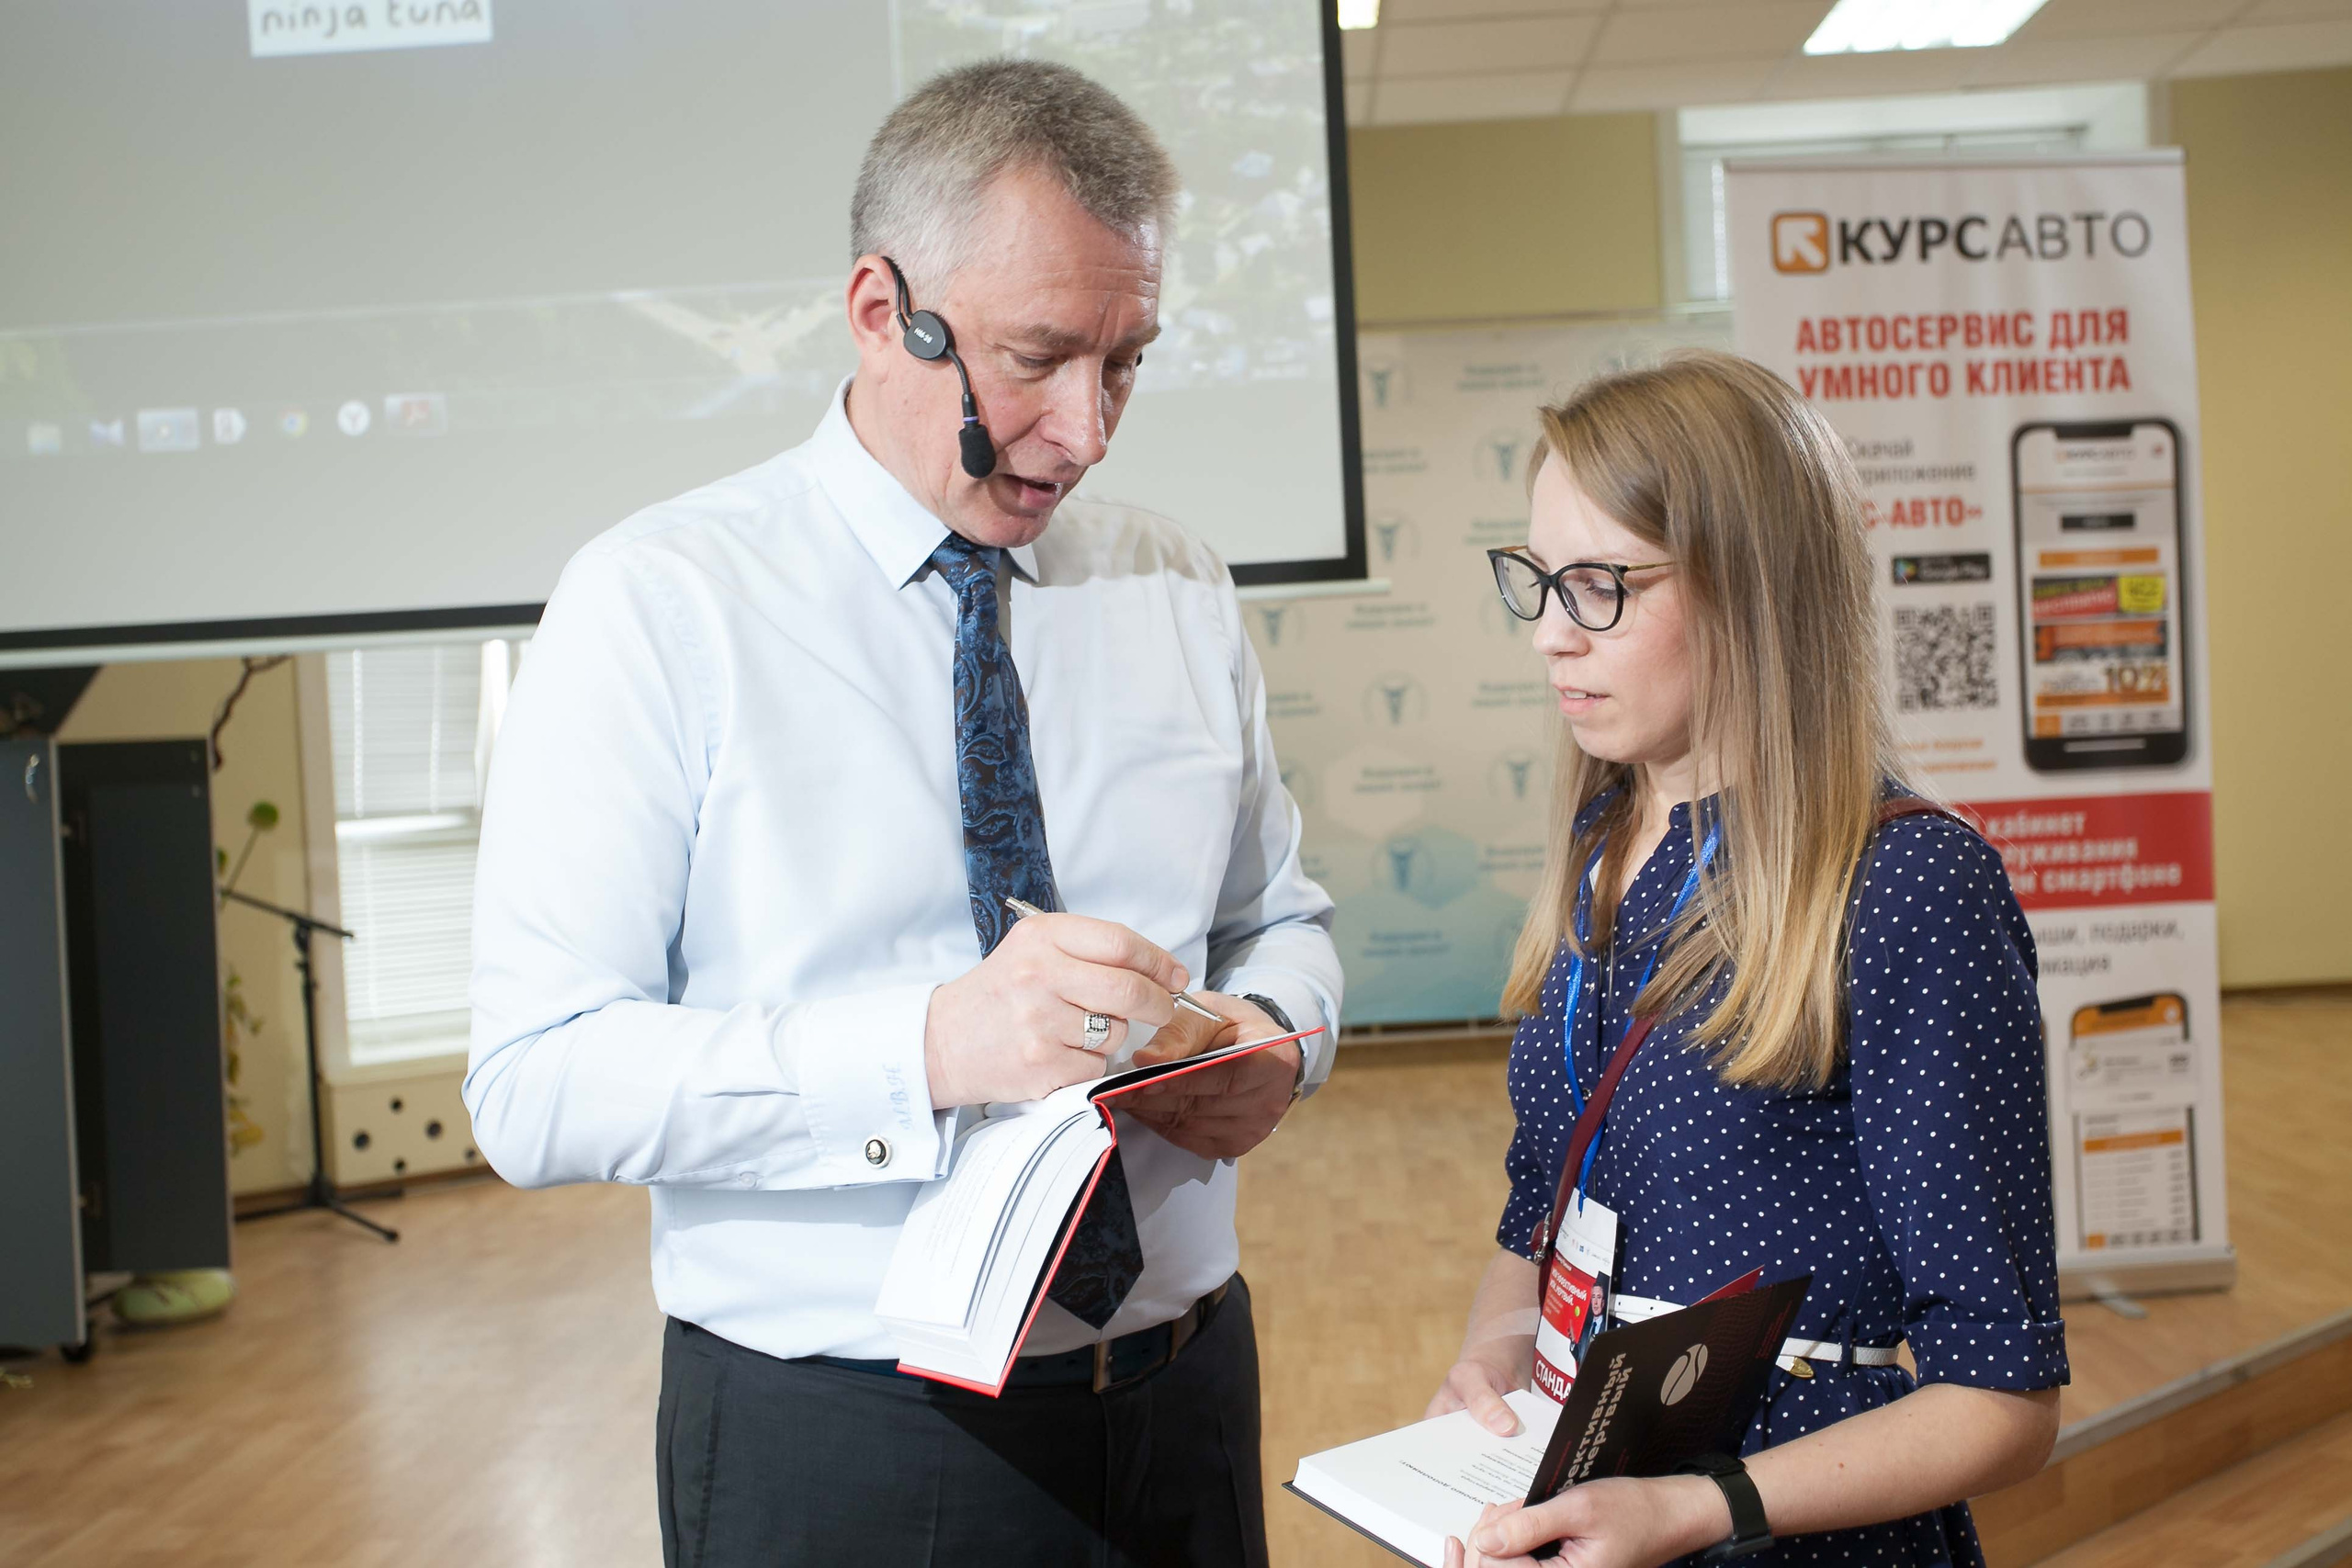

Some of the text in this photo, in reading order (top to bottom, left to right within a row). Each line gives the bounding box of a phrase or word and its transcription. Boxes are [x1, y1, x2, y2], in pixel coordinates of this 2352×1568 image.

[262, 0, 484, 39] ninja tuna
[1839, 210, 2152, 265] КУРСАВТО
[1795, 308, 2130, 355] АВТОСЕРВИС ДЛЯ
[1797, 356, 2132, 402] УМНОГО КЛИЕНТА
[1859, 463, 1976, 486] риложение
[1987, 810, 2087, 837] кабинет
[2042, 861, 2182, 897] смартфоне
[1535, 1359, 1572, 1401] СТАНДА
